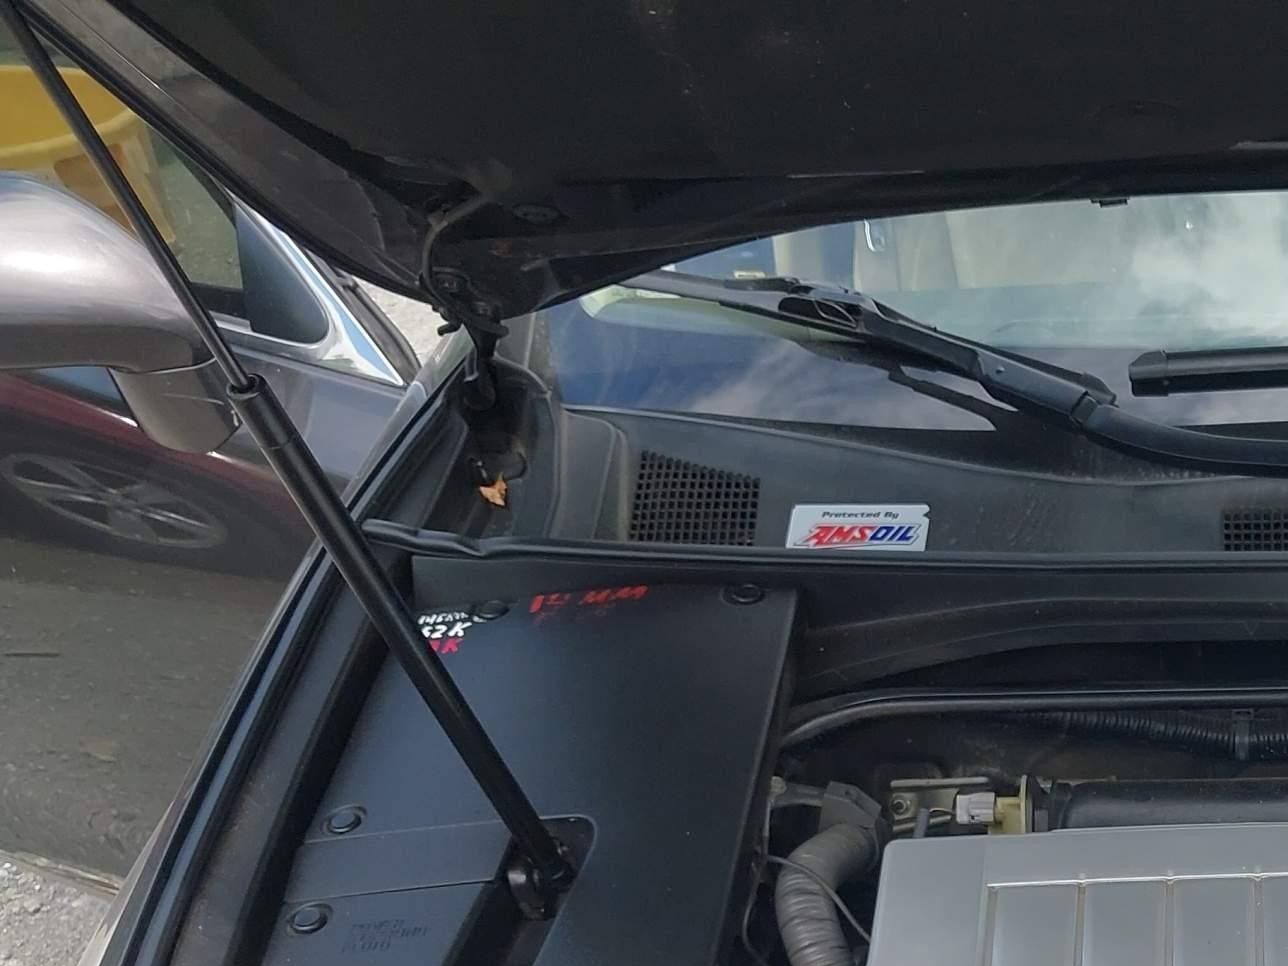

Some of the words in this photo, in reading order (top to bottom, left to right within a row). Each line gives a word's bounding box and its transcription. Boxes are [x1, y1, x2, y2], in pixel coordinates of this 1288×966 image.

[821, 511, 881, 519] Protected
[883, 512, 900, 520] By
[802, 524, 919, 547] AMSOIL
